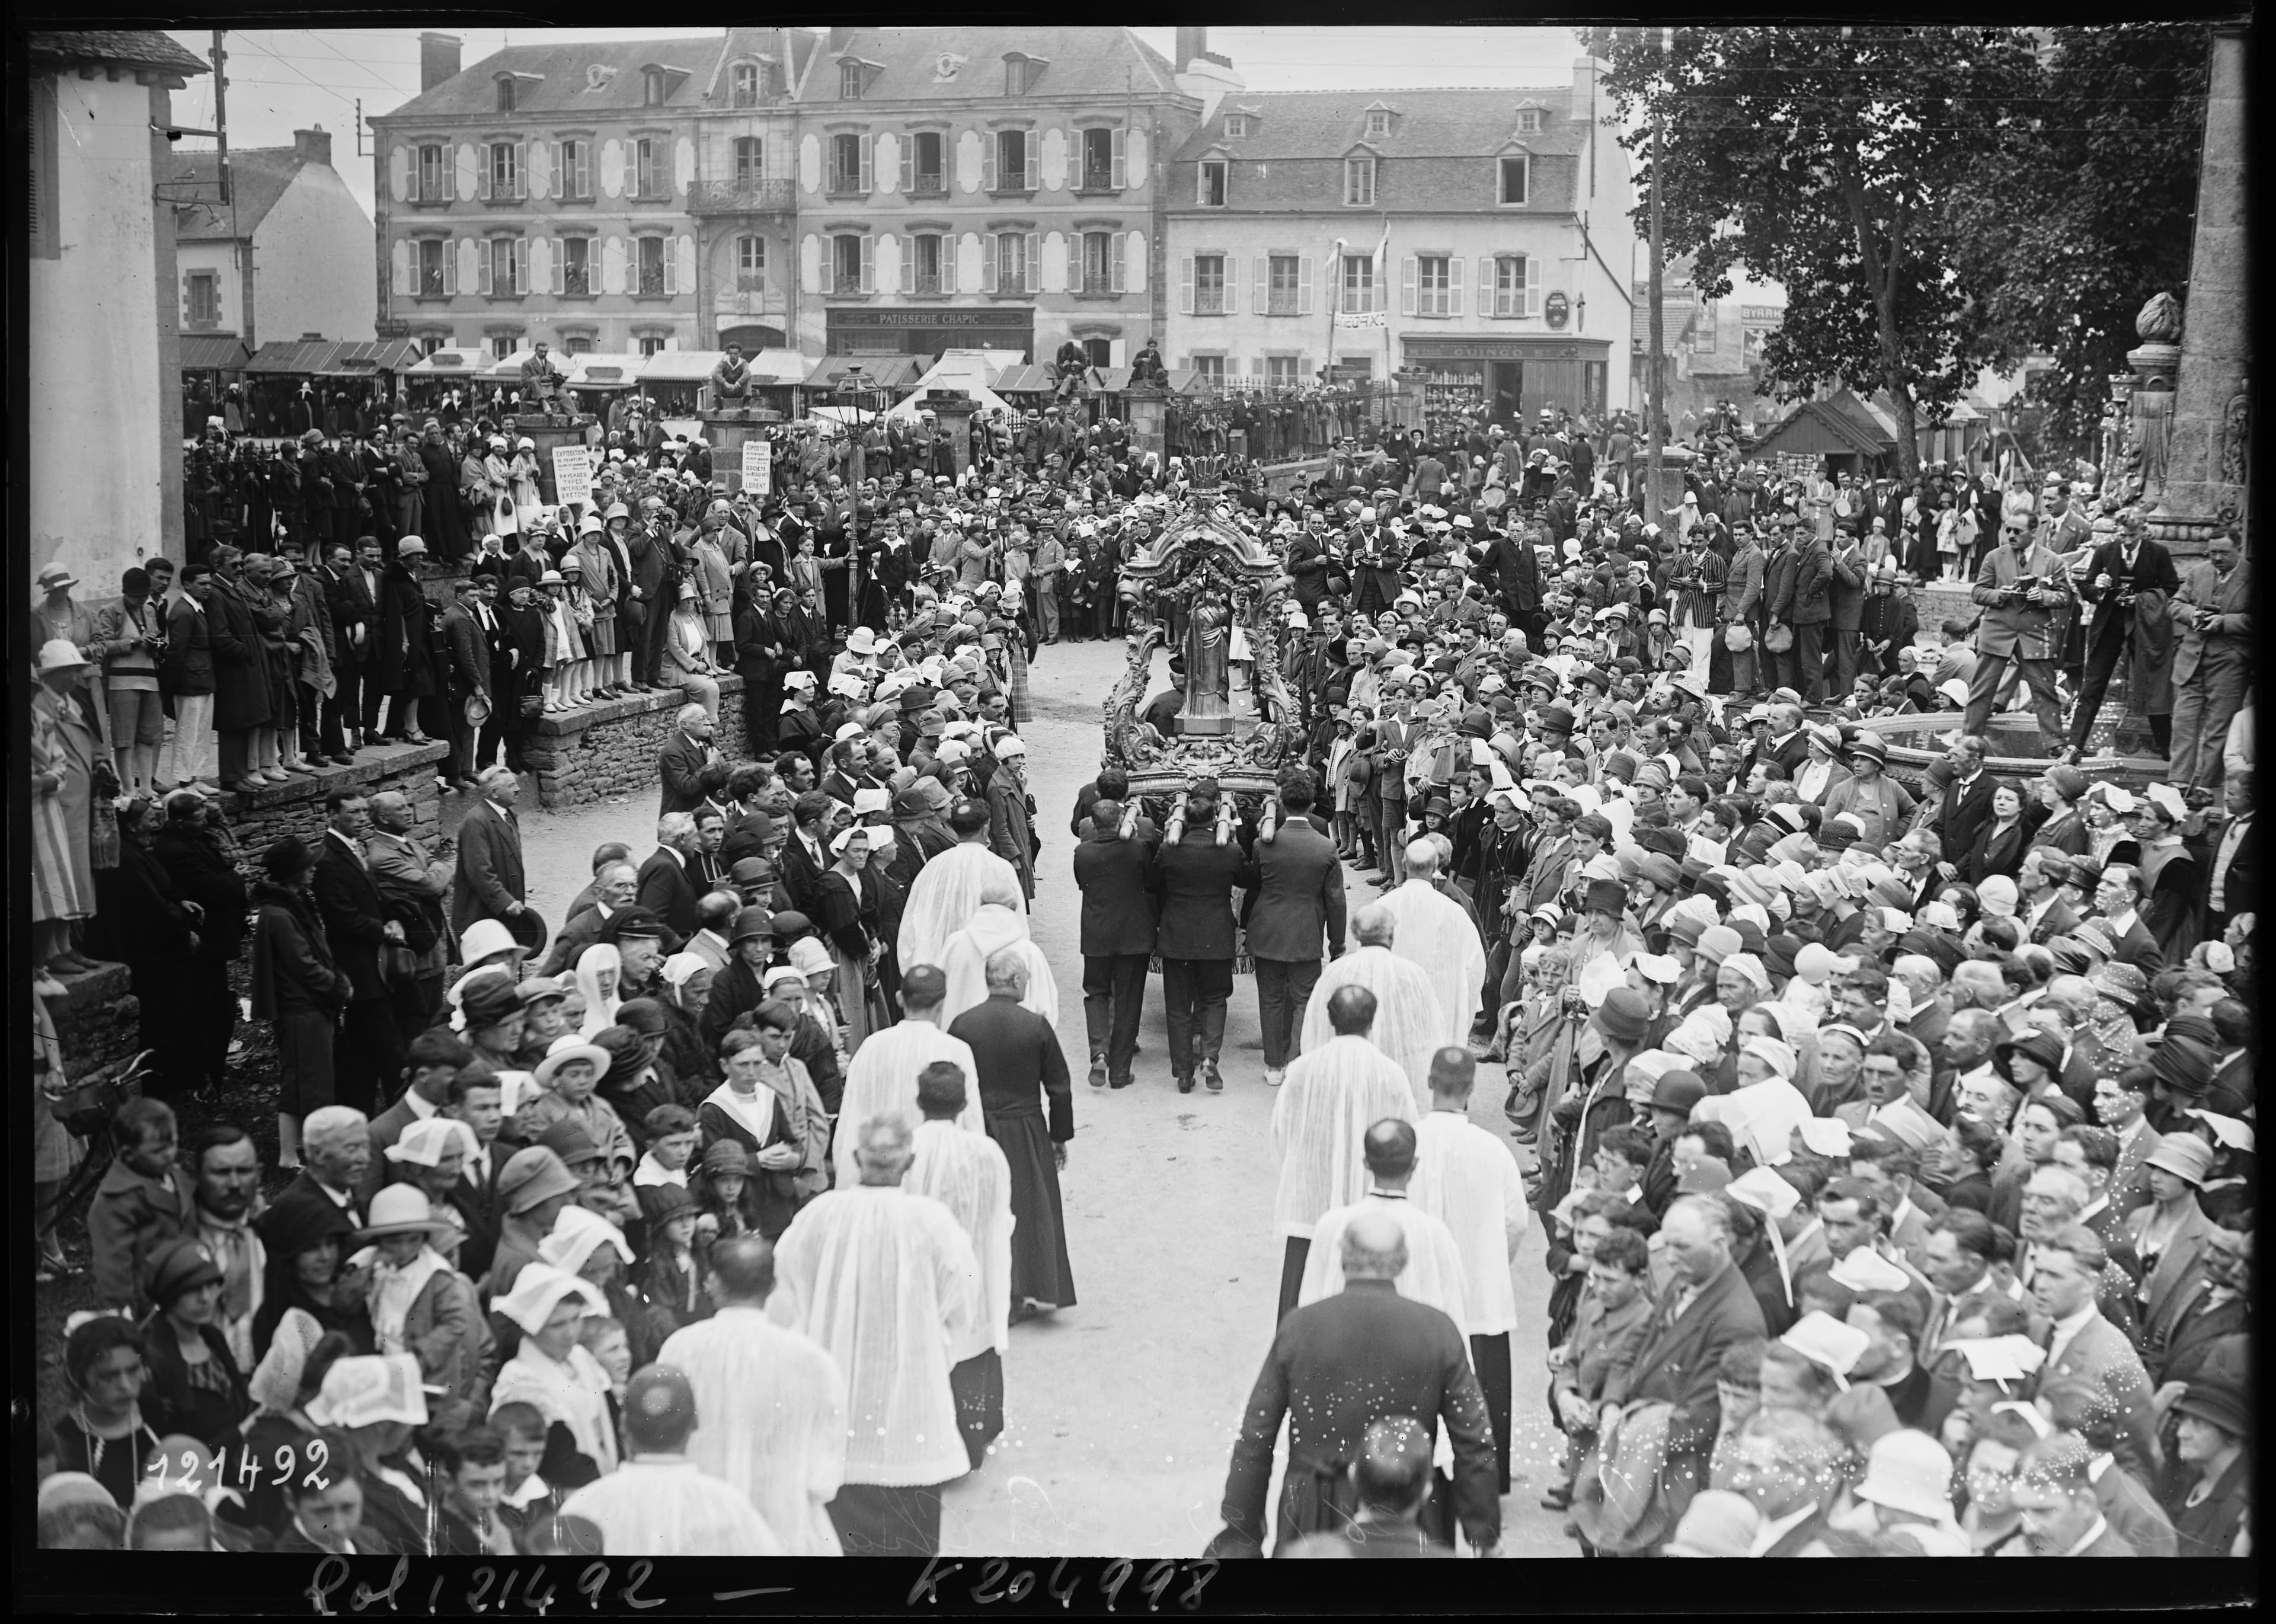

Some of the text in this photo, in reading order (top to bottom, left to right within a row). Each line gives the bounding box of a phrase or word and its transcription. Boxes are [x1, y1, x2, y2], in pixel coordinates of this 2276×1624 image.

[1743, 308, 1782, 318] BYRRH
[879, 314, 938, 324] PATISSERIE
[942, 314, 979, 324] CHAPIC
